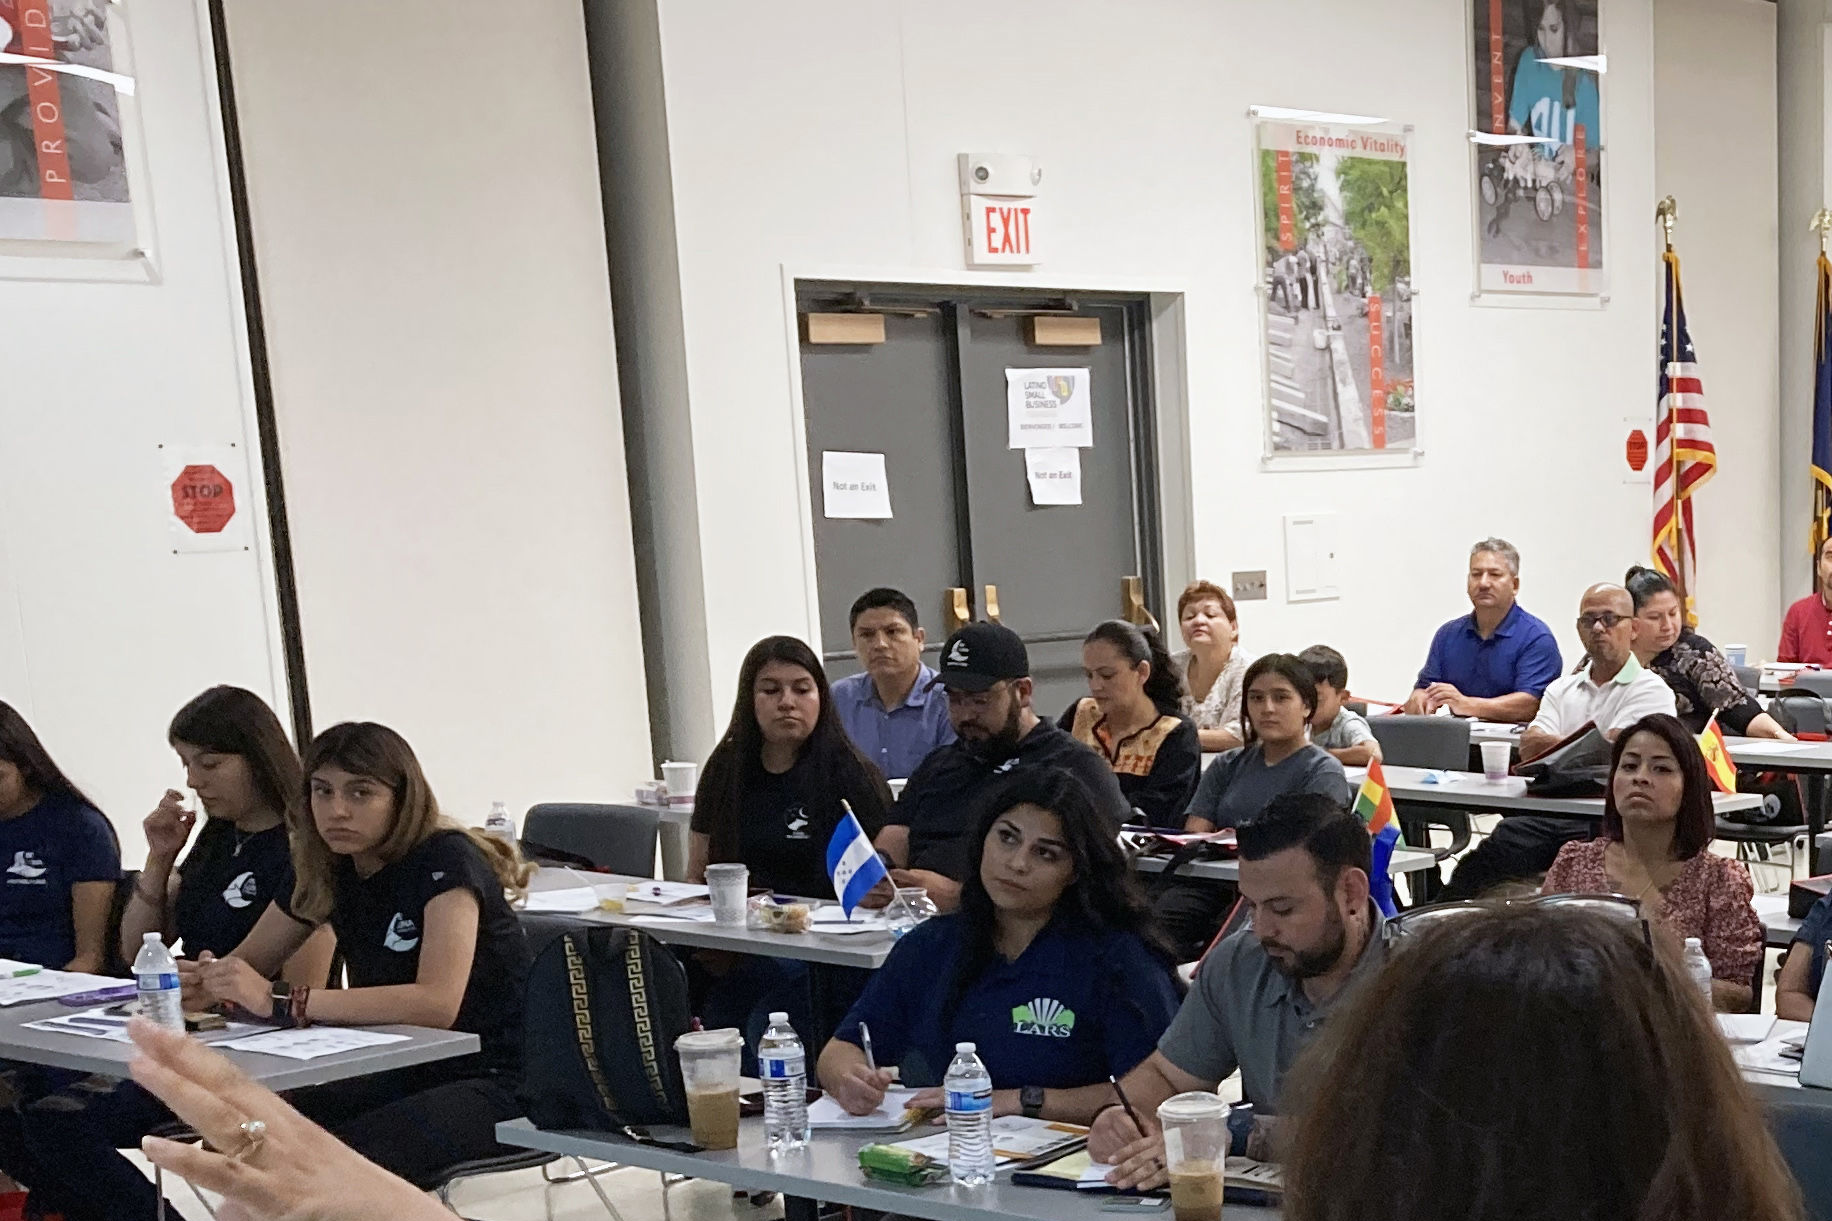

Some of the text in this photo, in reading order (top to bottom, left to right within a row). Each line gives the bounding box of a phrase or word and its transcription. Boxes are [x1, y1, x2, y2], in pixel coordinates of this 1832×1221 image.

[1296, 130, 1406, 158] Economic Vitality
[1278, 152, 1293, 242] SPIRIT
[1575, 131, 1588, 251] EXPLORE
[985, 206, 1031, 254] EXIT
[1502, 269, 1533, 284] Youth
[1369, 303, 1384, 435] SUCCESS
[833, 480, 848, 491] Not
[860, 481, 876, 492] Exit
[1035, 471, 1048, 480] Not
[1058, 471, 1073, 480] Exit
[181, 483, 224, 500] STOP
[1014, 1021, 1071, 1038] LARS
